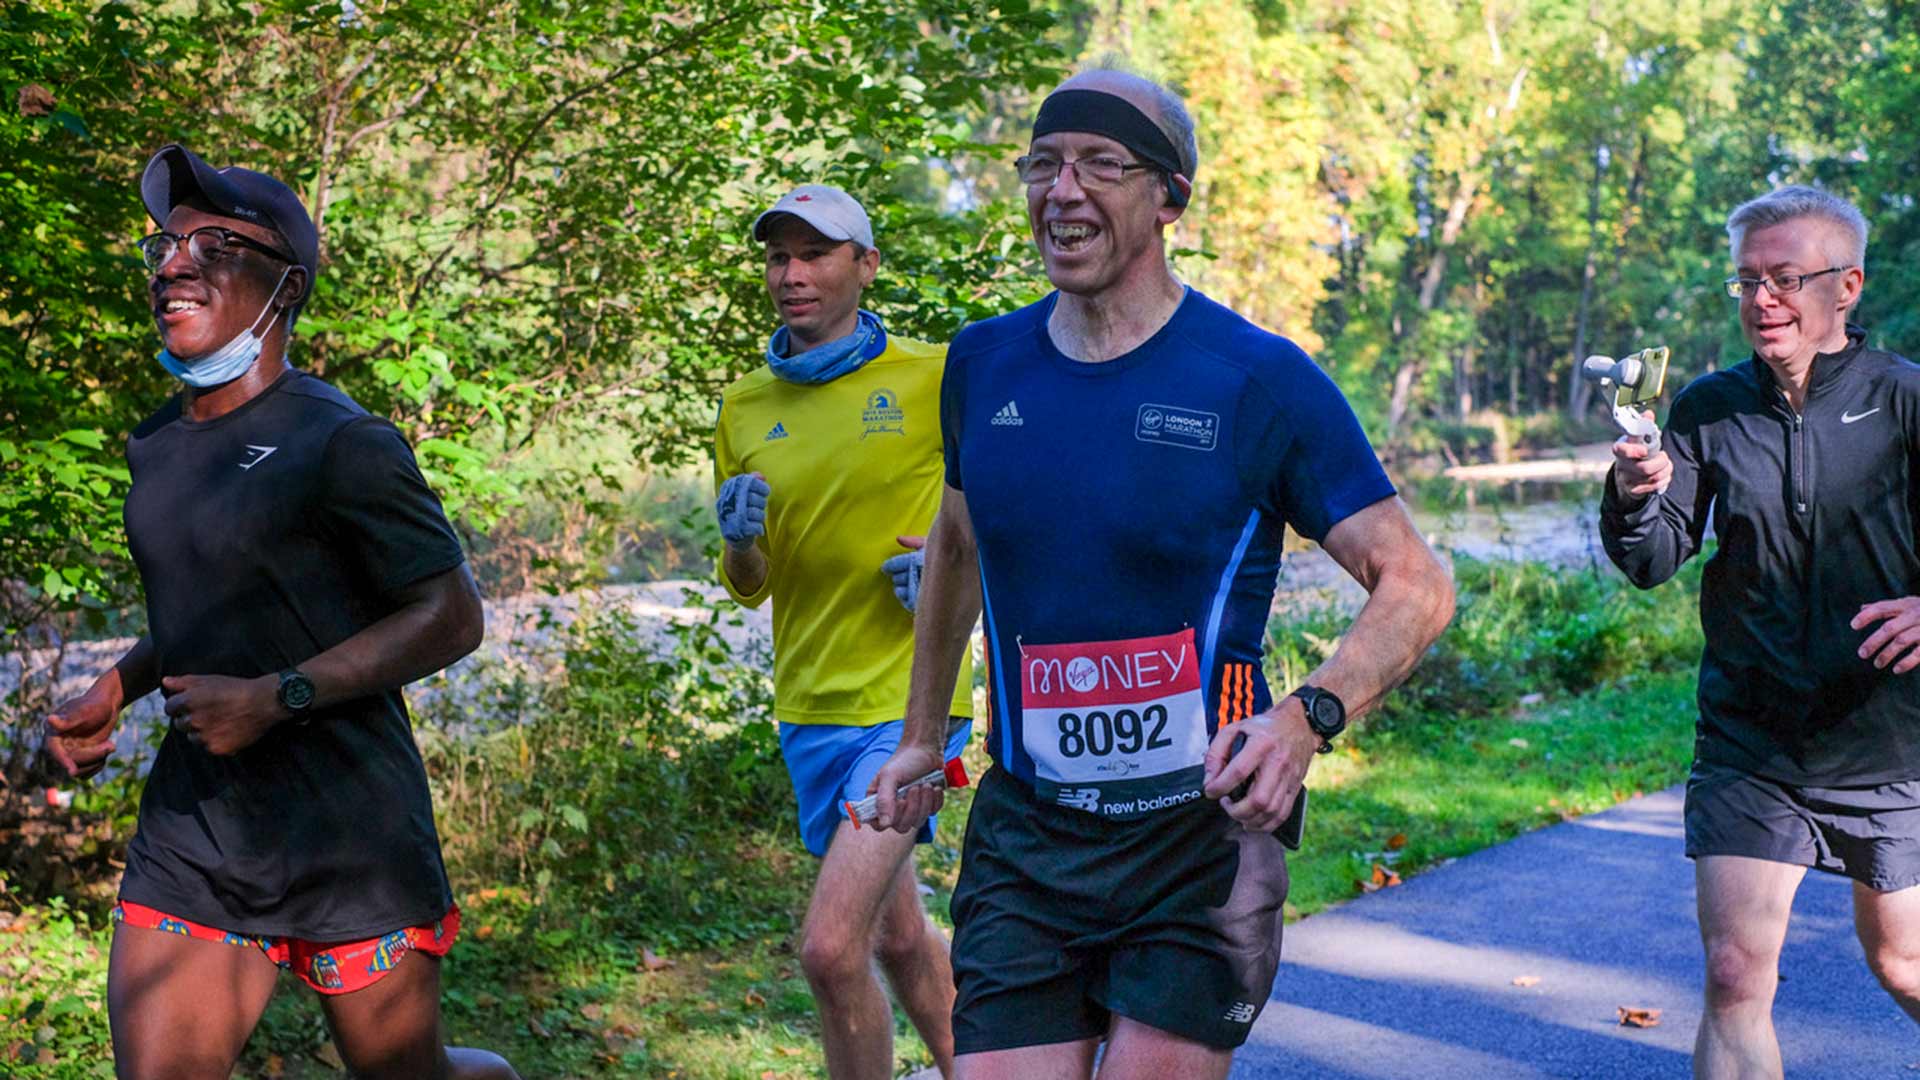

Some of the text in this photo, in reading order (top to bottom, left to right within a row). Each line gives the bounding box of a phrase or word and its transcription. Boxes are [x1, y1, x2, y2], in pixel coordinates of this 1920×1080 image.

[991, 415, 1024, 426] adidas
[1165, 414, 1203, 427] LONDON
[1164, 423, 1213, 436] MARATHON
[1057, 703, 1173, 758] 8092
[1103, 800, 1135, 815] new
[1137, 789, 1201, 812] balance
